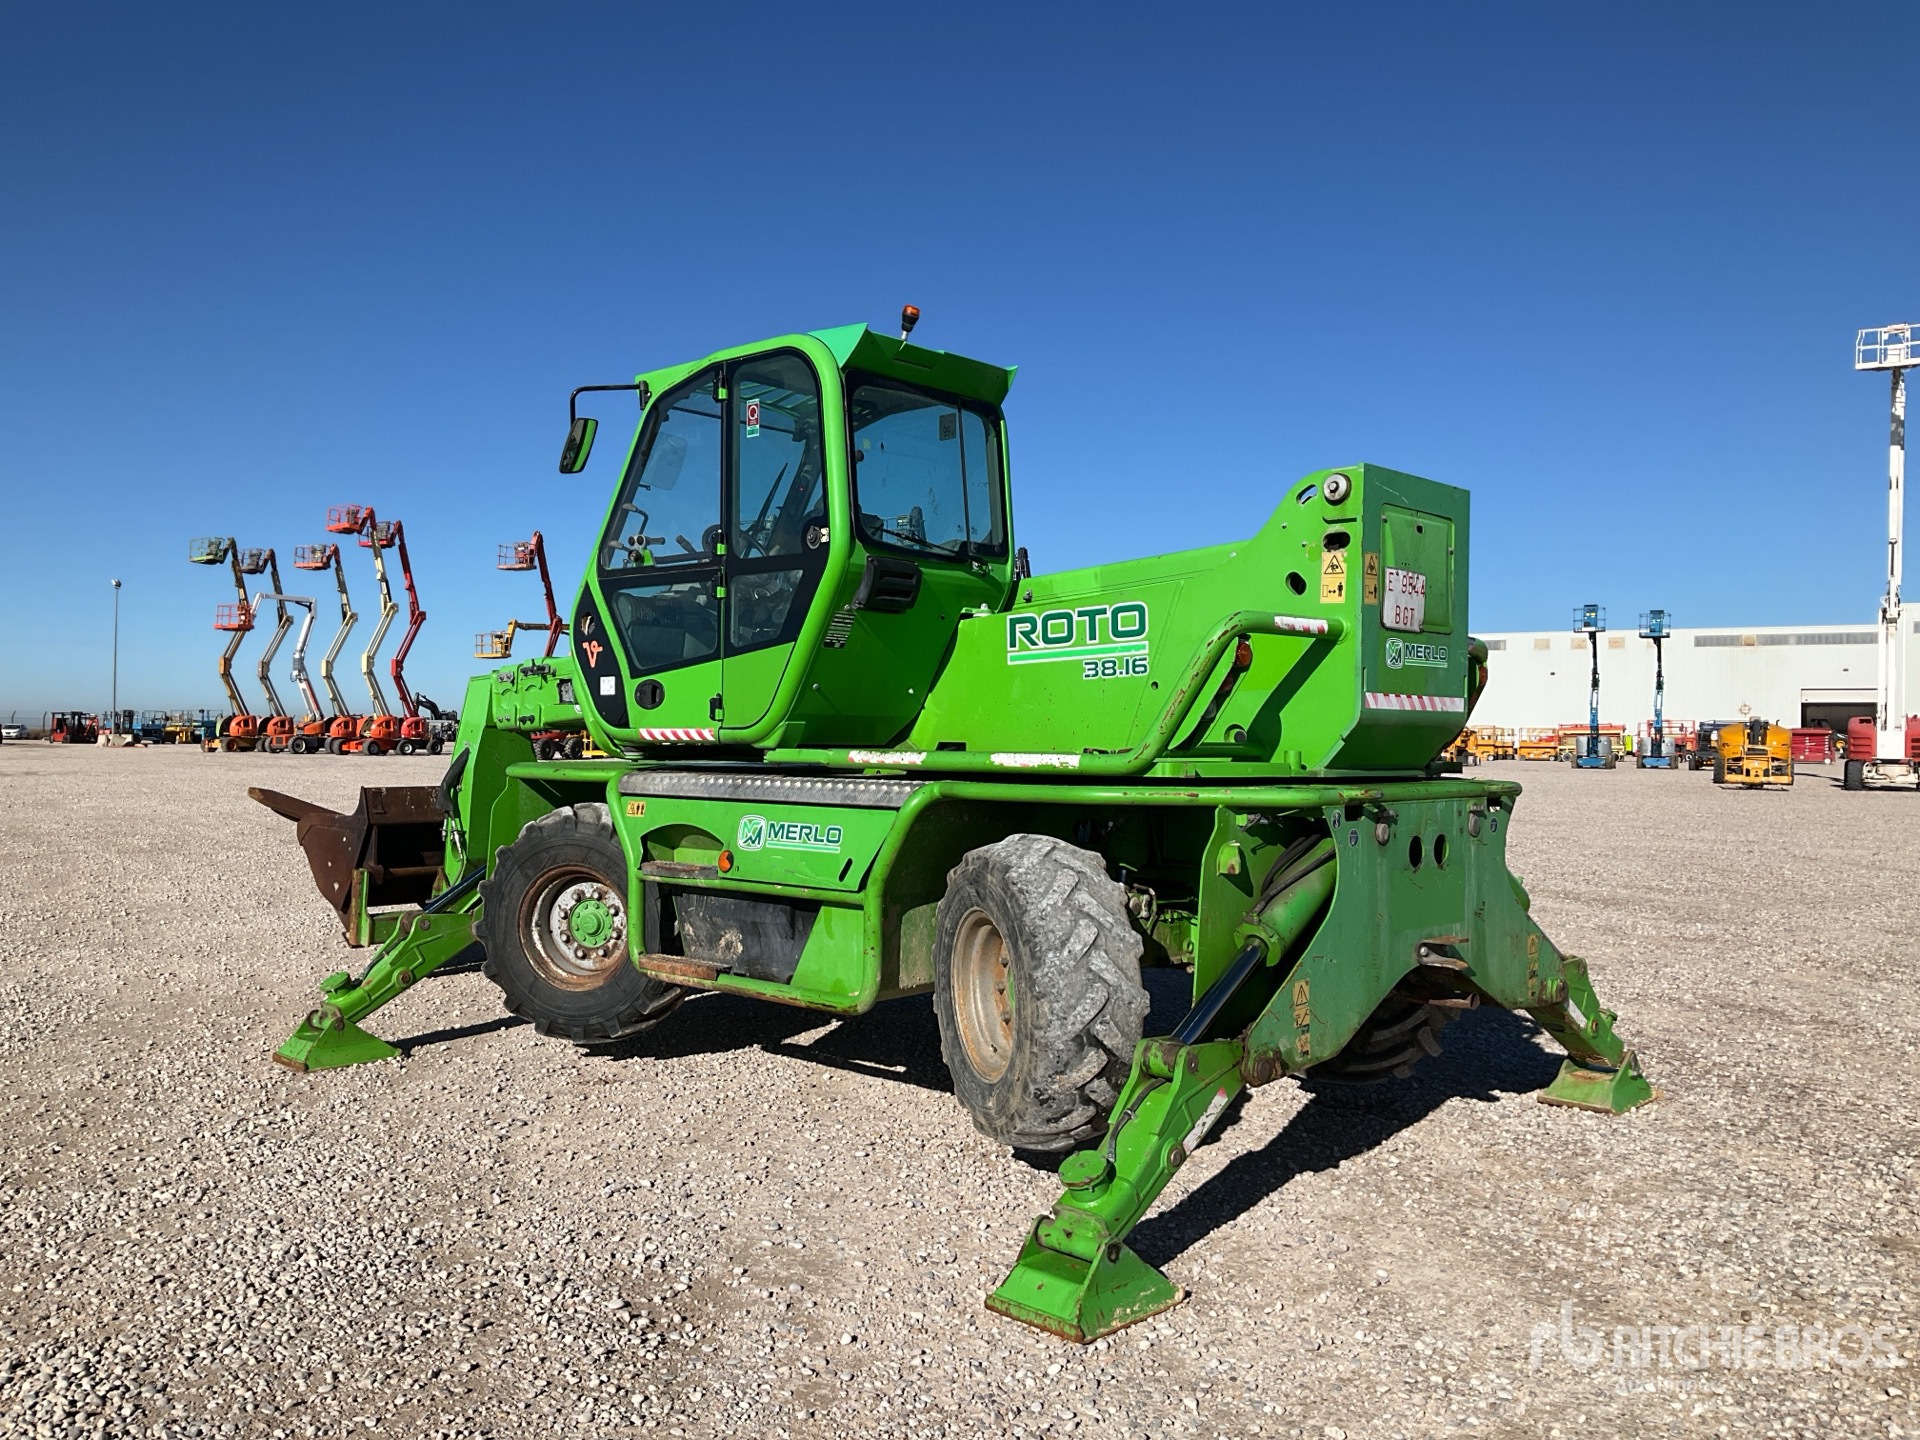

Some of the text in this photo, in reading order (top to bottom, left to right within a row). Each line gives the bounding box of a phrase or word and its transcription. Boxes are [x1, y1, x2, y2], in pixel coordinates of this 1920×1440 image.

[1007, 601, 1149, 652] ROTO
[1394, 604, 1415, 627] BGT
[1404, 643, 1448, 661] MERLO
[1083, 655, 1149, 680] 38.16
[767, 821, 843, 846] MERLO
